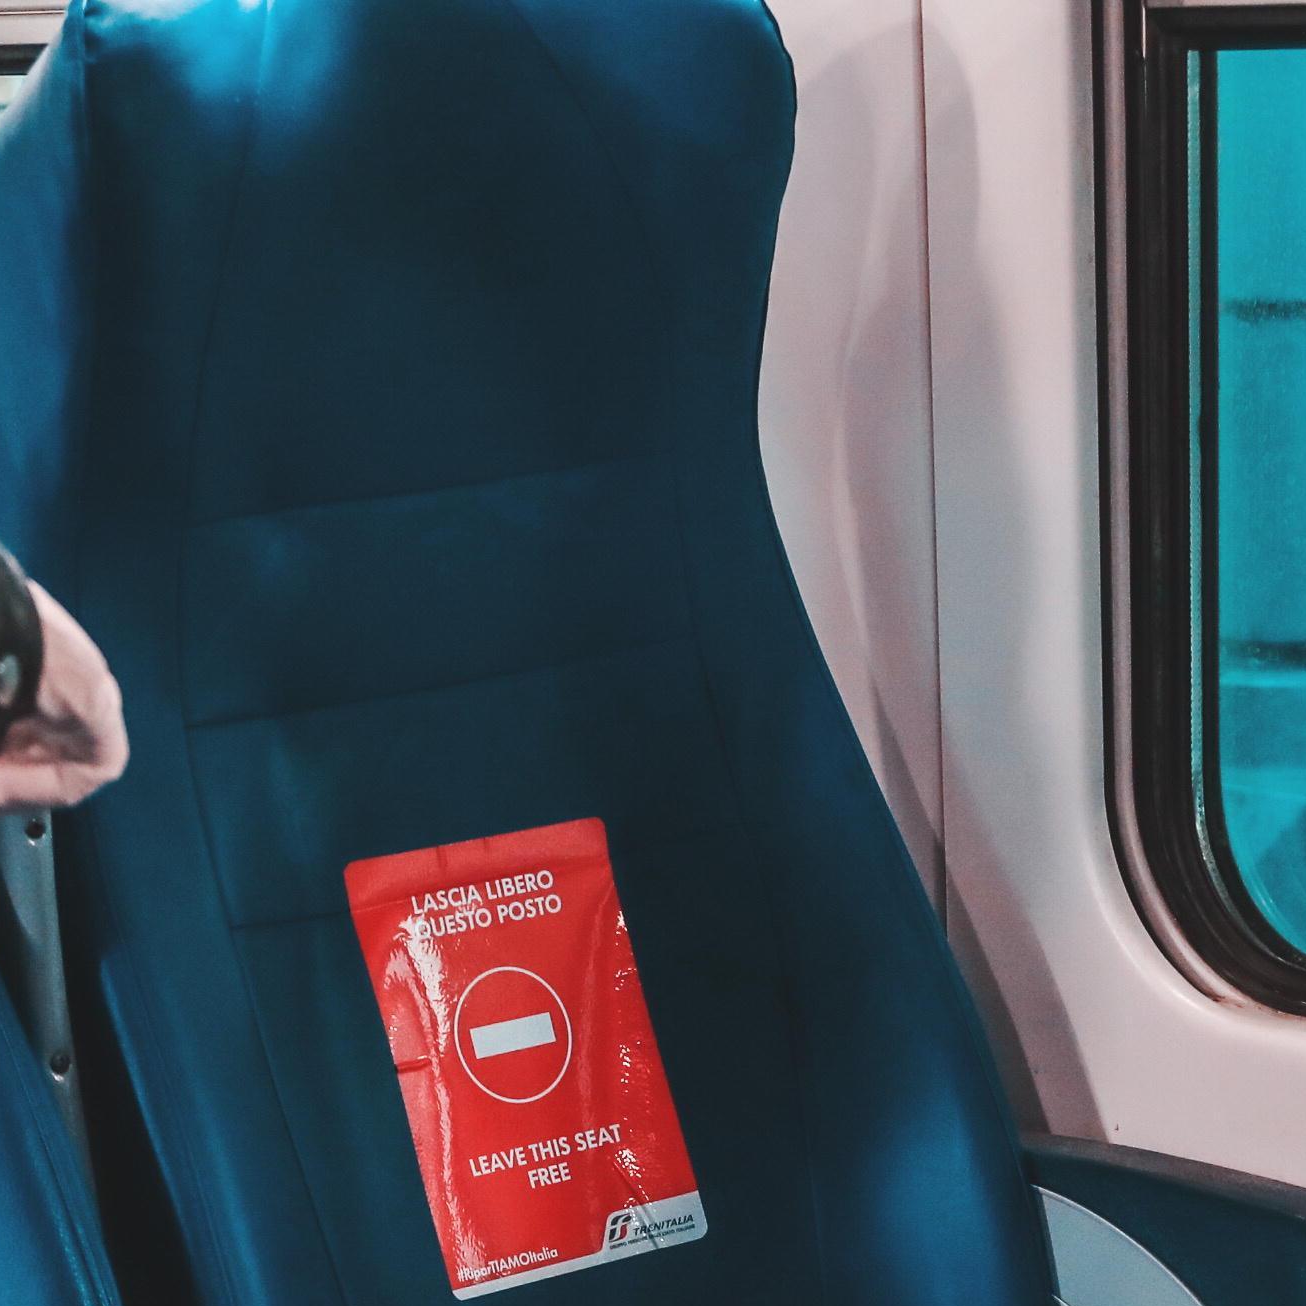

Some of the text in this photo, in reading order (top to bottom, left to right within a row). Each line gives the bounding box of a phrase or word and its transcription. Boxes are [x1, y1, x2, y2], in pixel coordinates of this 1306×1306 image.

[411, 870, 554, 915] LASCIA LIBERO
[415, 894, 562, 940] QUESTO POSTO
[469, 1124, 622, 1177] LEAVE THIS SEAT
[528, 1162, 572, 1189] FREE
[633, 1214, 694, 1236] TRENITALIA
